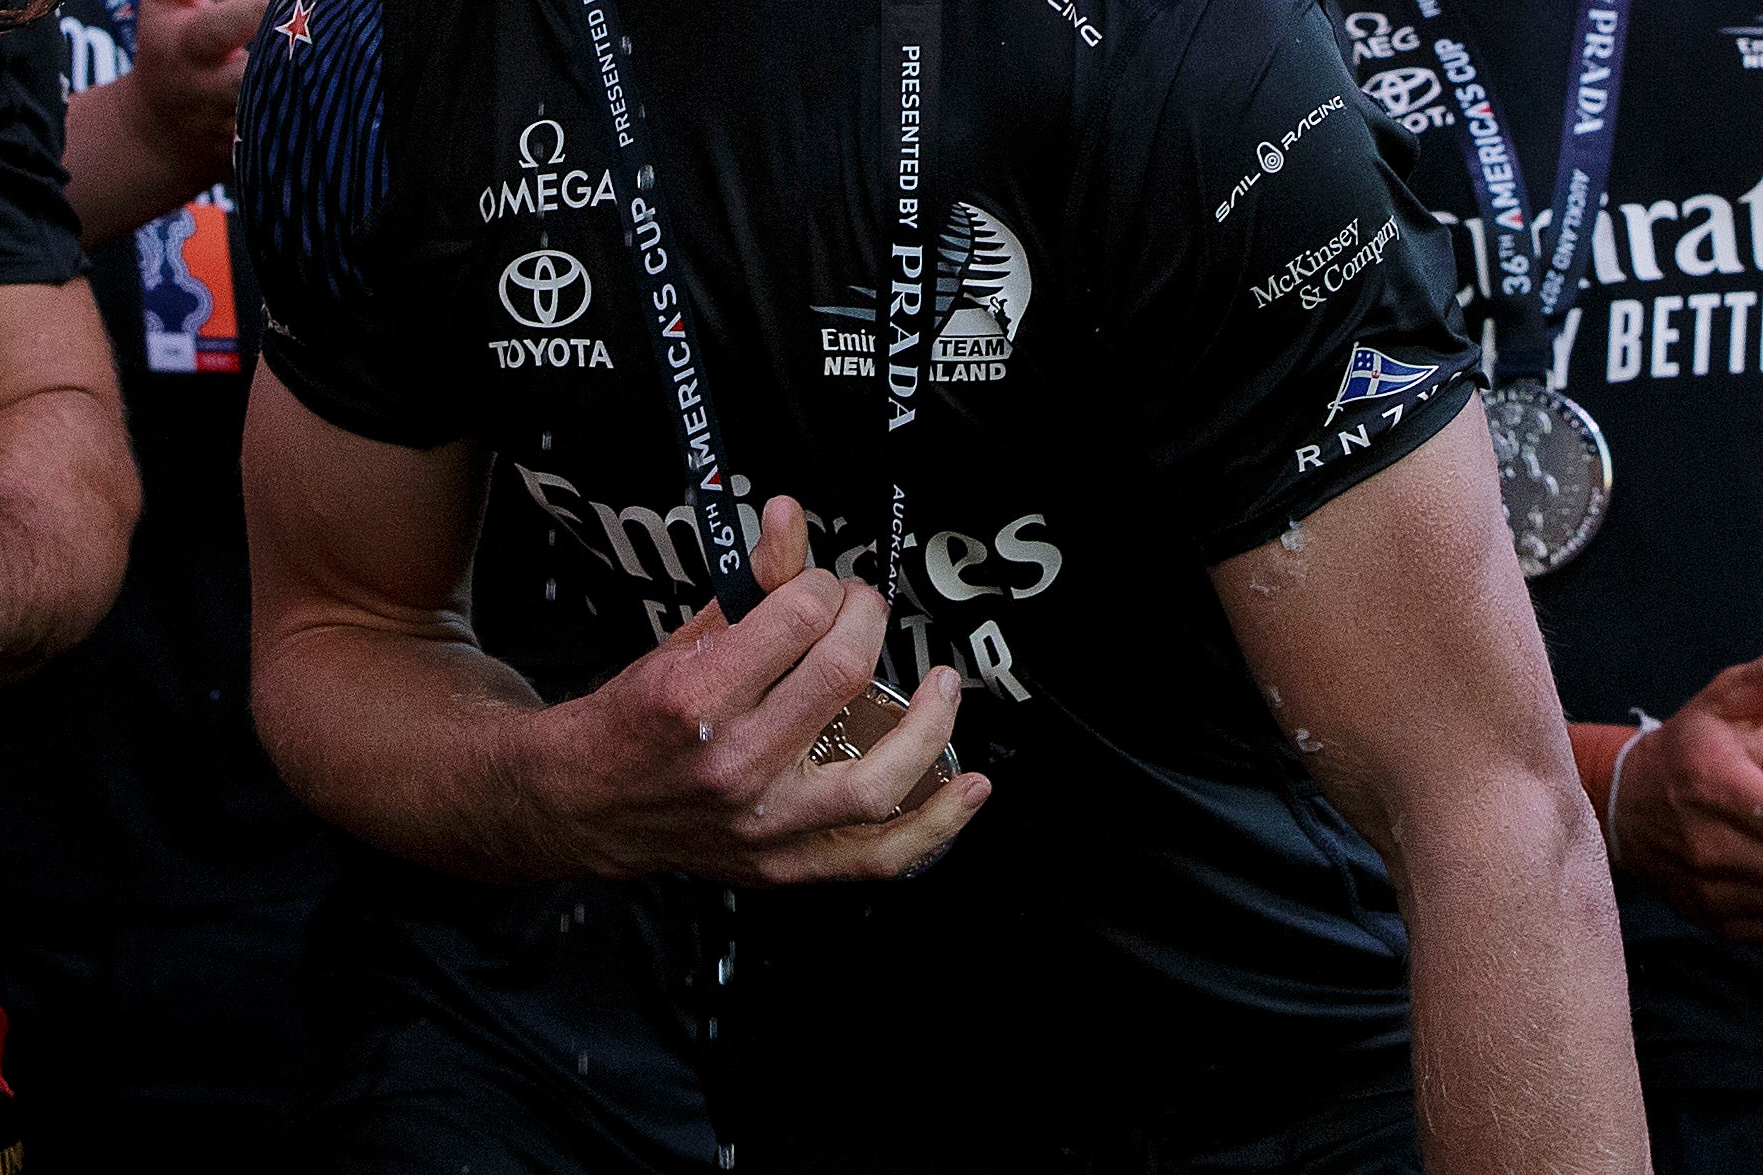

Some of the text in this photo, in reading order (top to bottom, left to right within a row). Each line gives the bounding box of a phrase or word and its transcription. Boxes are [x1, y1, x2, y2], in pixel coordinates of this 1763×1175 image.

[588, 9, 634, 147] PRESENTED
[1434, 38, 1477, 84] CUP
[1574, 8, 1619, 136] PRADA
[479, 169, 618, 223] OMEGA
[1214, 172, 1261, 223] SAIL
[1280, 95, 1344, 151] RACING
[888, 45, 923, 433] PRESENTED BY PRADA
[1249, 217, 1361, 310] McKinsey
[1300, 214, 1401, 311] & Company
[1499, 233, 1532, 296] 36TH
[489, 338, 614, 369] TOYOTA
[631, 197, 741, 574] 36TH AMERICA'S CUP
[939, 339, 1005, 357] TEAM
[887, 484, 905, 610] AUCKLAN
